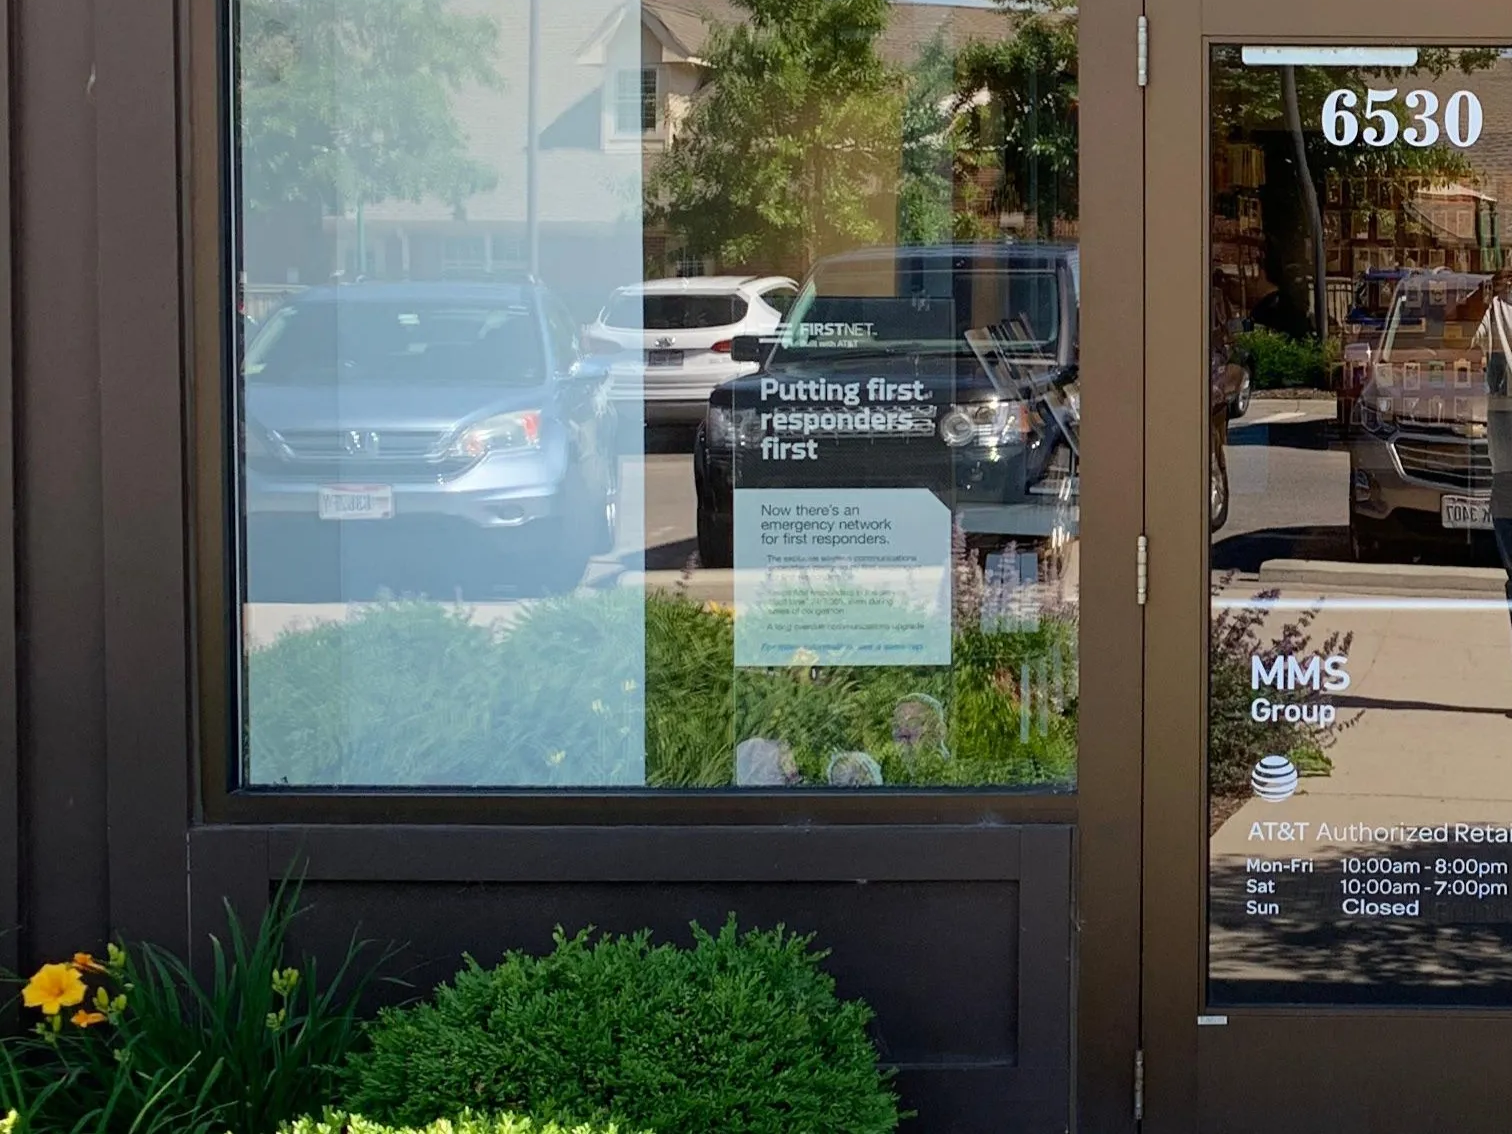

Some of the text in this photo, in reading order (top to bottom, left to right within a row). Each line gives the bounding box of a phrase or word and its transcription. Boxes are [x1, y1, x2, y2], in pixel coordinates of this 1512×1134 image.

[1321, 88, 1483, 147] 6530
[800, 322, 875, 336] FIRSTNET
[760, 377, 924, 406] Putting first
[760, 407, 913, 434] responders
[760, 436, 818, 460] first
[761, 504, 860, 516] Now there's an
[761, 519, 892, 533] emergency network
[761, 533, 890, 546] for first responders.
[1251, 655, 1350, 691] MMS
[1251, 698, 1335, 727] Group
[1247, 822, 1309, 842] AT&T
[1316, 822, 1448, 843] Authorized
[1246, 858, 1313, 873] Mon-Fri
[1246, 879, 1275, 893] Sat
[1246, 899, 1420, 915] Sun Closed
